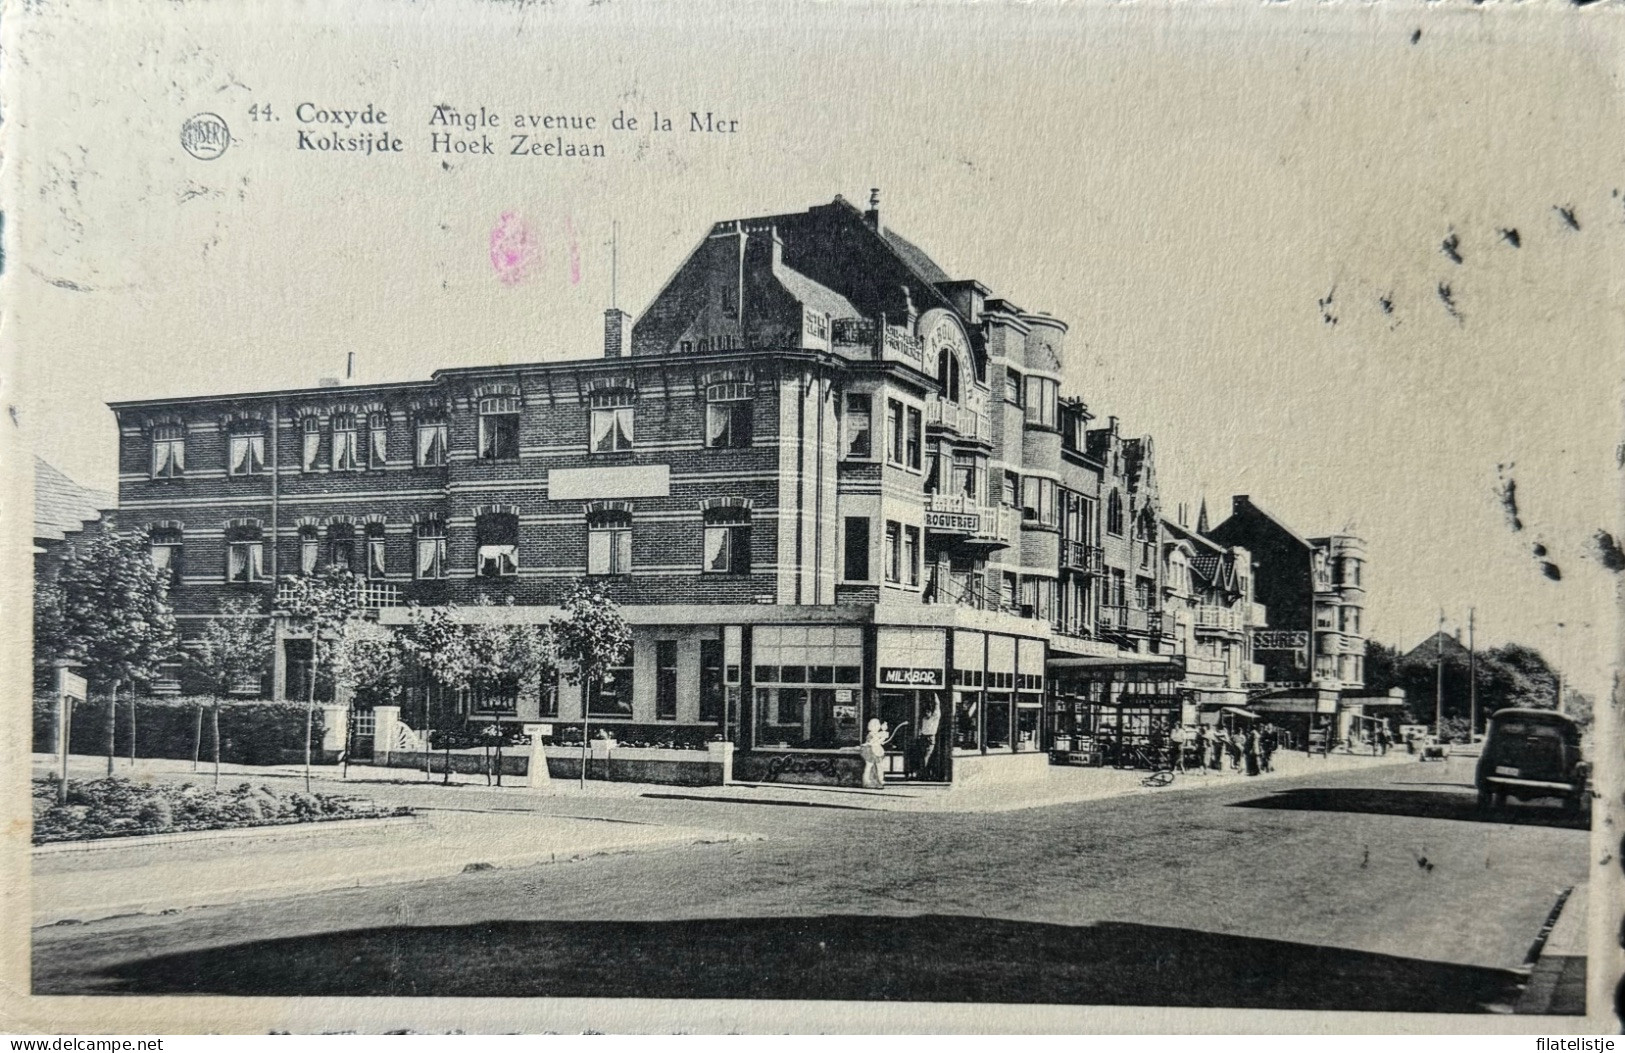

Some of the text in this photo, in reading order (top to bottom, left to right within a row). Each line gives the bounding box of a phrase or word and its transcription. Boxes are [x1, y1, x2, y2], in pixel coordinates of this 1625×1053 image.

[248, 103, 739, 133] 44. Coxyde Angle avenue de la Mer
[297, 131, 605, 157] Koksijde Hoek Zeelaan
[885, 670, 937, 685] MILK BAR
